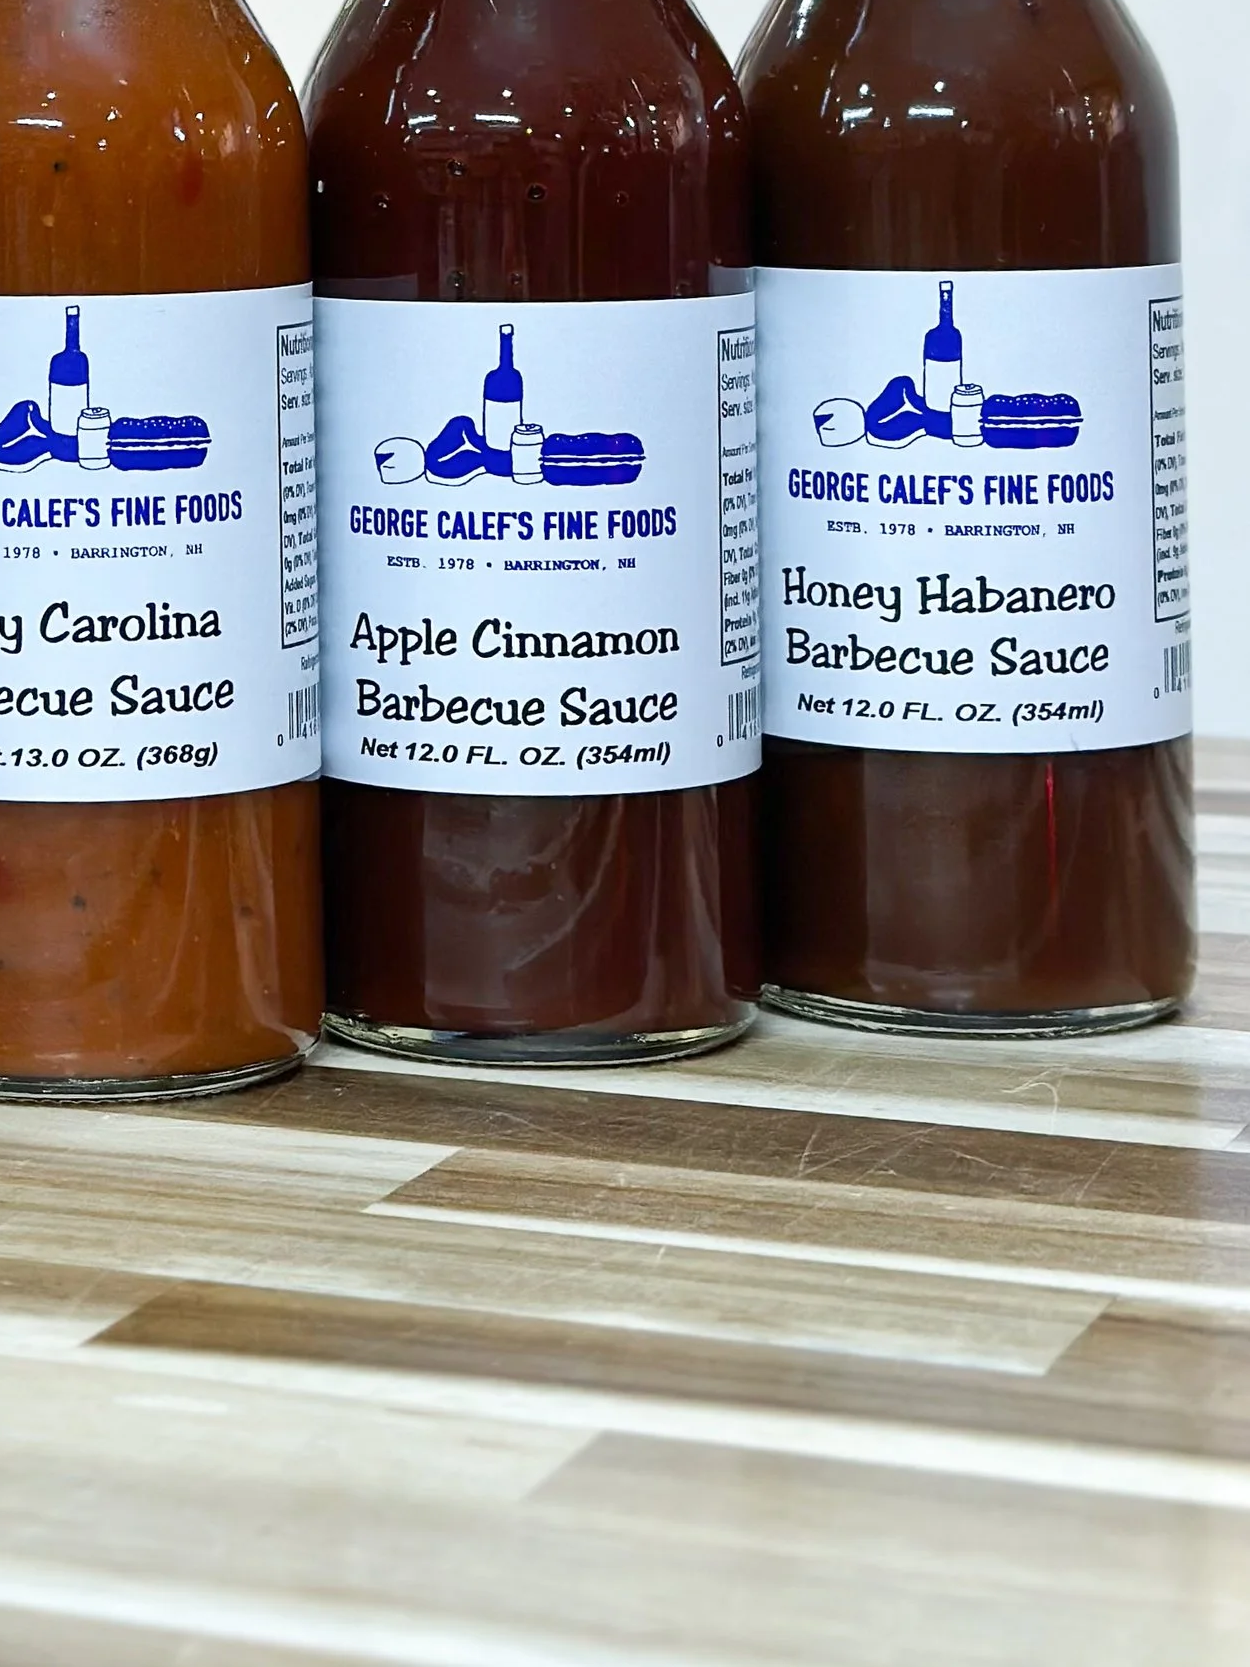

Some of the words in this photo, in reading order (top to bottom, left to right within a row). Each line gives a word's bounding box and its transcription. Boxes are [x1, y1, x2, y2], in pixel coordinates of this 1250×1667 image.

[788, 468, 869, 503] GEORGE
[879, 474, 974, 505] CALEF'S
[984, 474, 1038, 505] FINE
[1047, 471, 1114, 504] FOODS
[2, 498, 100, 528] CALEF'S
[111, 496, 166, 527] FINE
[175, 490, 242, 524] FOODS
[350, 505, 428, 538] GEORGE
[438, 511, 533, 540] CALEF'S
[544, 511, 598, 540] FINE
[608, 506, 676, 539] FOODS
[827, 520, 867, 534] ESTB.
[880, 523, 915, 535] 1978
[945, 524, 1045, 537] BARRINGTON,
[1058, 523, 1074, 534] NH
[4, 547, 40, 559] 1978
[71, 546, 173, 559] BARRINGTON,
[186, 544, 202, 555] NH
[387, 556, 426, 568] ESTB.
[439, 558, 474, 570] 1978
[504, 559, 606, 571] BARRINGTON,
[618, 558, 636, 569] NH
[782, 566, 901, 622] Honey
[916, 573, 1115, 615] Habanero
[40, 601, 222, 643] Carolina
[350, 612, 457, 666] Apple
[472, 618, 680, 658] Cinnamon
[786, 627, 973, 675] Barbecue
[990, 637, 1109, 676] Sauce
[111, 674, 234, 716] Sauce
[356, 678, 545, 726] Barbecue
[560, 687, 677, 727] Sauce
[798, 693, 835, 714] Net
[842, 698, 894, 718] 12.0
[902, 702, 943, 721] FL.
[955, 704, 1001, 722] OZ.
[1012, 700, 1104, 727] (354ml)
[11, 748, 68, 767] 13.0
[78, 748, 125, 767] OZ.
[137, 742, 218, 771] (368g)
[277, 733, 284, 746] 0
[361, 737, 398, 758] Net
[405, 742, 458, 763] 12.0
[466, 746, 507, 765] FL.
[520, 747, 565, 765] OZ.
[577, 741, 670, 770] (354ml)
[716, 734, 723, 747] 0
